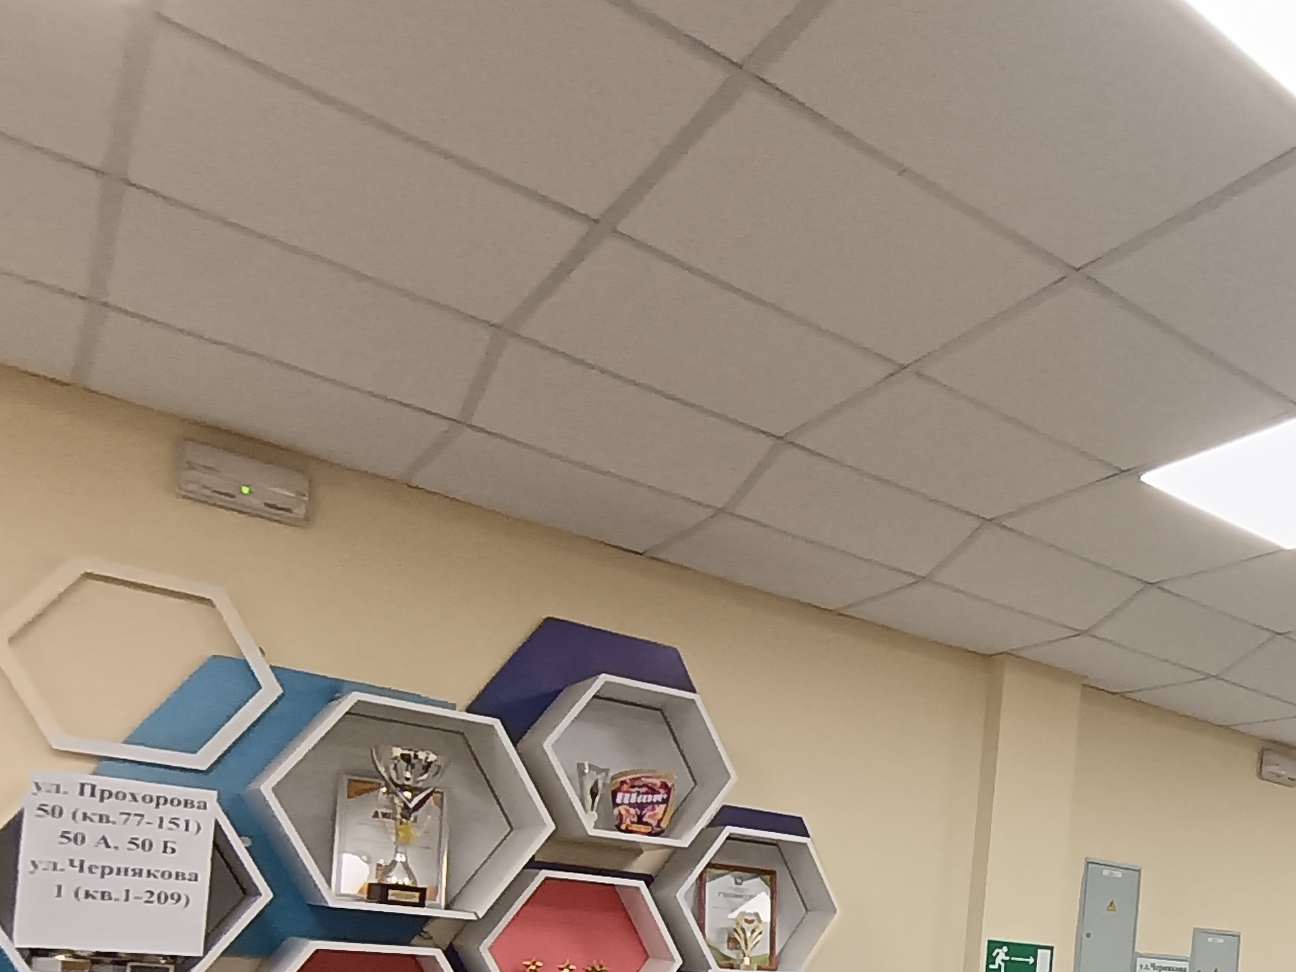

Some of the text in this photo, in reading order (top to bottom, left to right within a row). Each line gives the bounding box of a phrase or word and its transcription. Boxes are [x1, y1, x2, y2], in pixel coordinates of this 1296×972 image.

[32, 781, 208, 811] ул. Прохорова
[35, 803, 202, 835] 50 (кв.77-151)
[58, 830, 177, 855] 50 А, 50 Б
[55, 884, 190, 909] 1 (кв.1-209)
